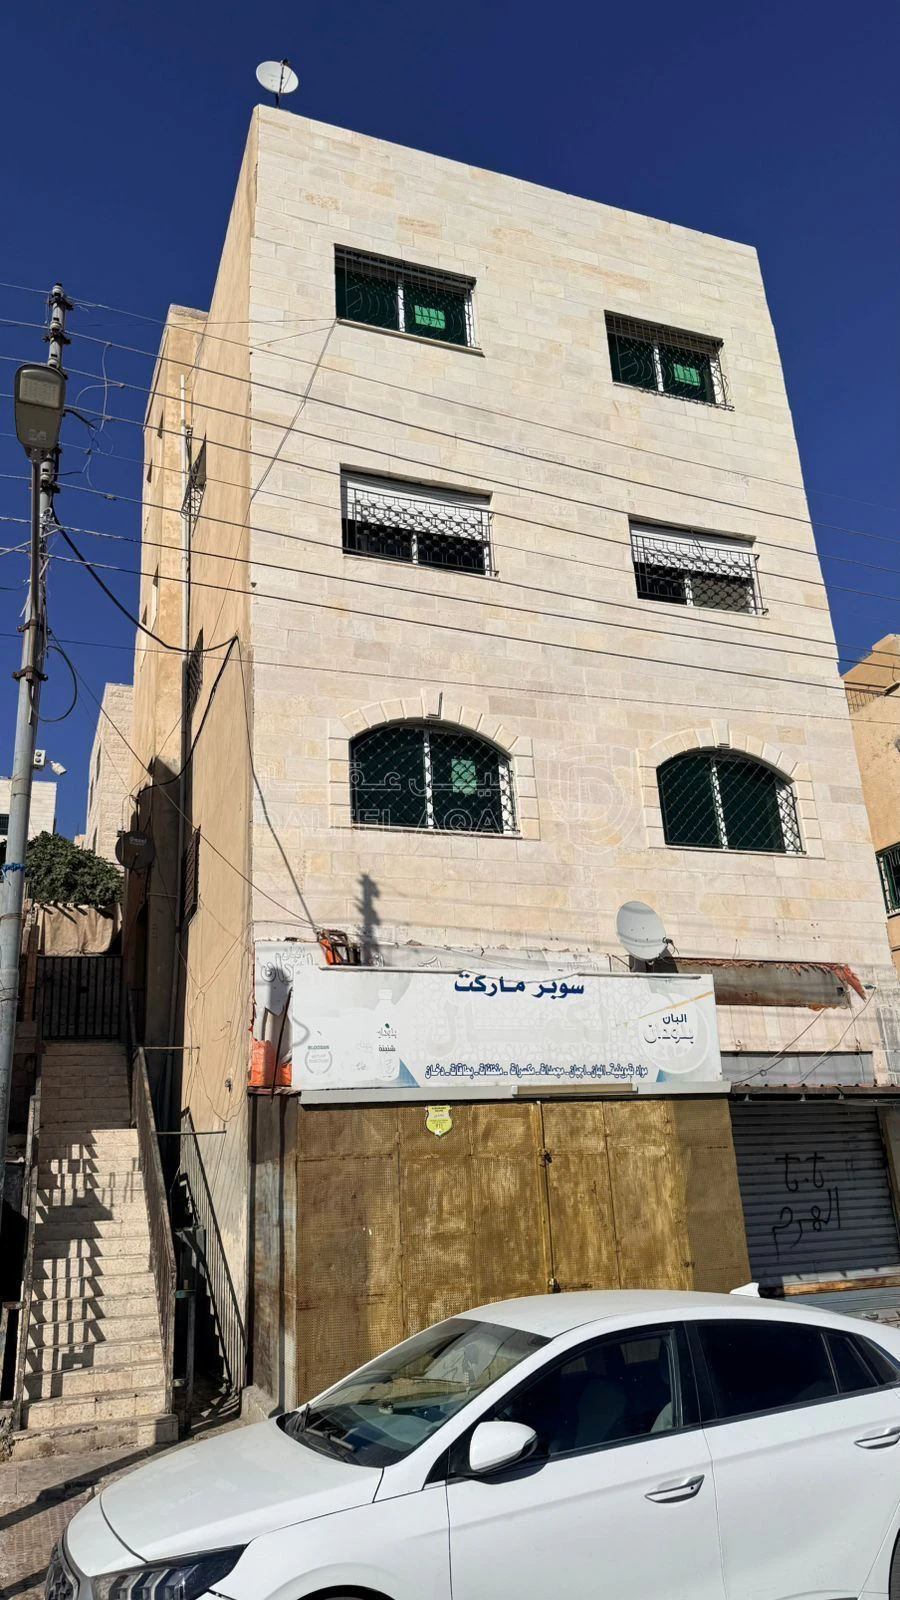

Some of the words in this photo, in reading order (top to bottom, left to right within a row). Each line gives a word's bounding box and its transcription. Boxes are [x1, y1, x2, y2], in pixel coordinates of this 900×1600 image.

[454, 973, 525, 997] ماركت
[530, 981, 584, 999] سوبر
[662, 1013, 687, 1025] البان
